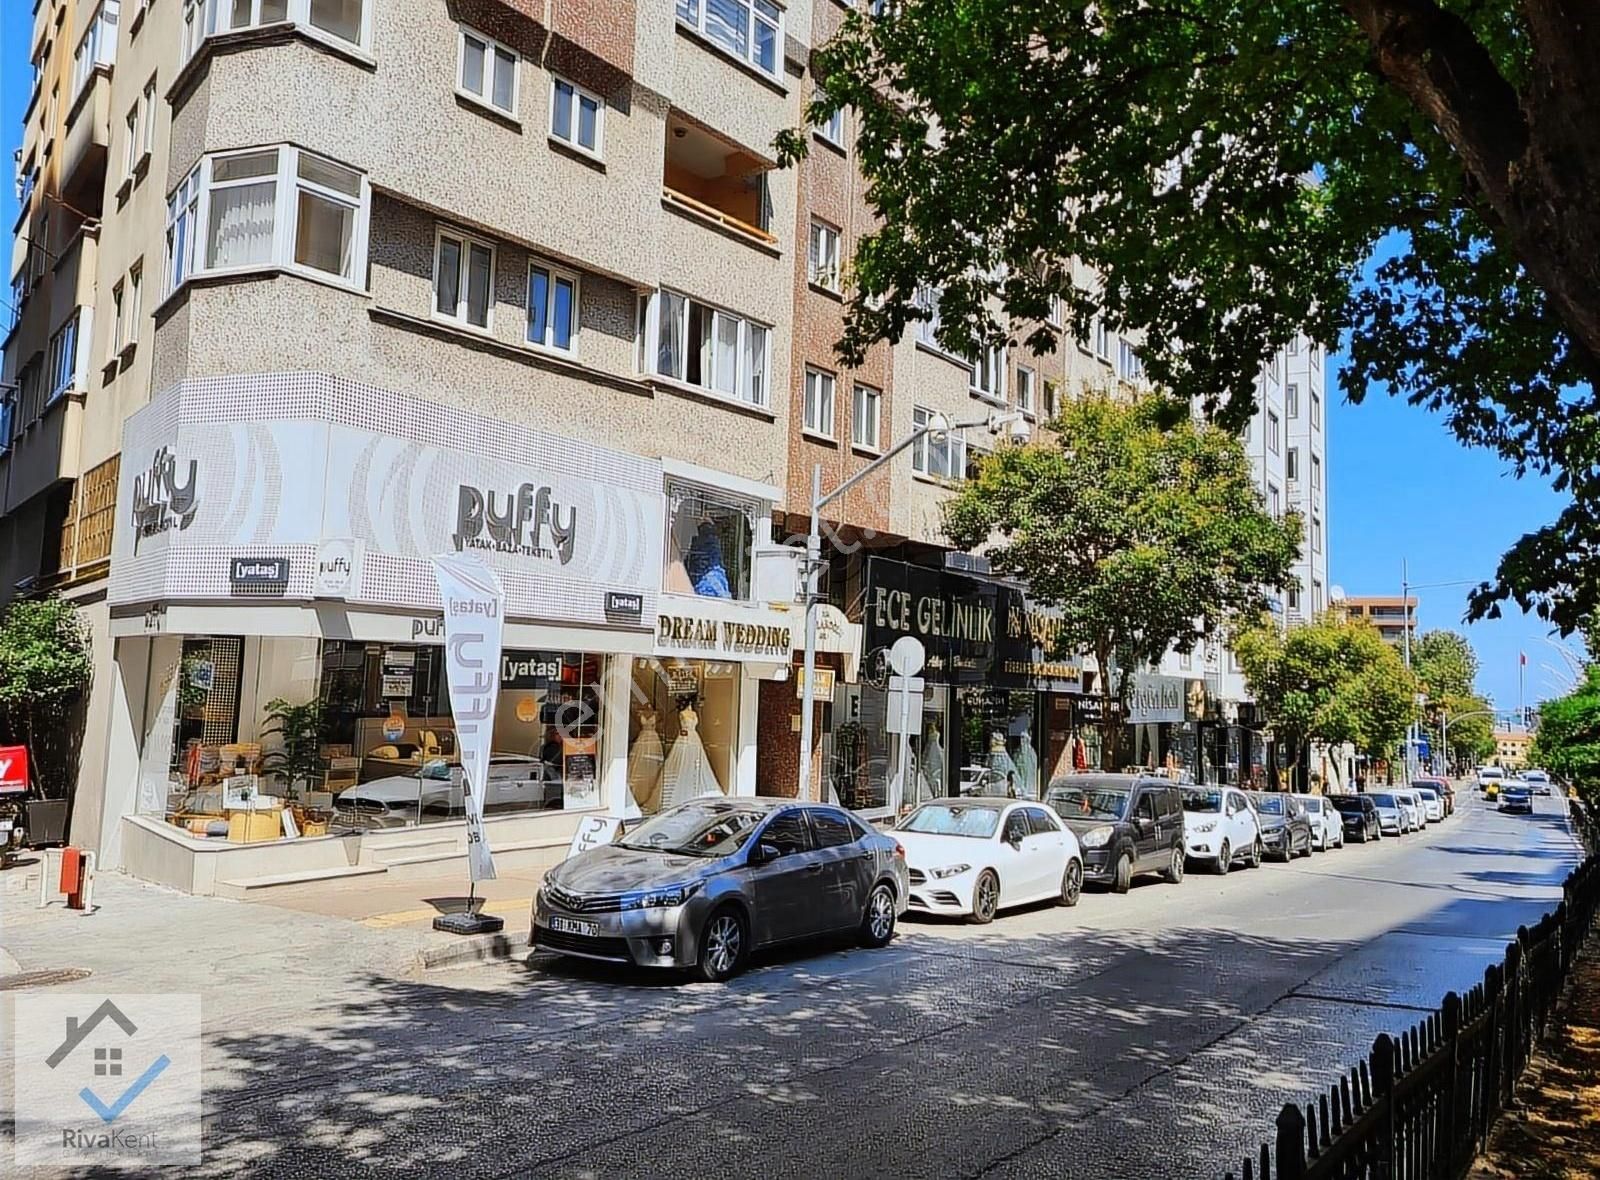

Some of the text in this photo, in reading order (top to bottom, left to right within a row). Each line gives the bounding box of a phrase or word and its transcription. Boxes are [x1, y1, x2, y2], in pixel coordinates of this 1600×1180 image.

[452, 482, 577, 566] puffy
[658, 614, 718, 642] DREAM
[722, 621, 791, 648] WEDDING
[875, 586, 911, 632] ECE
